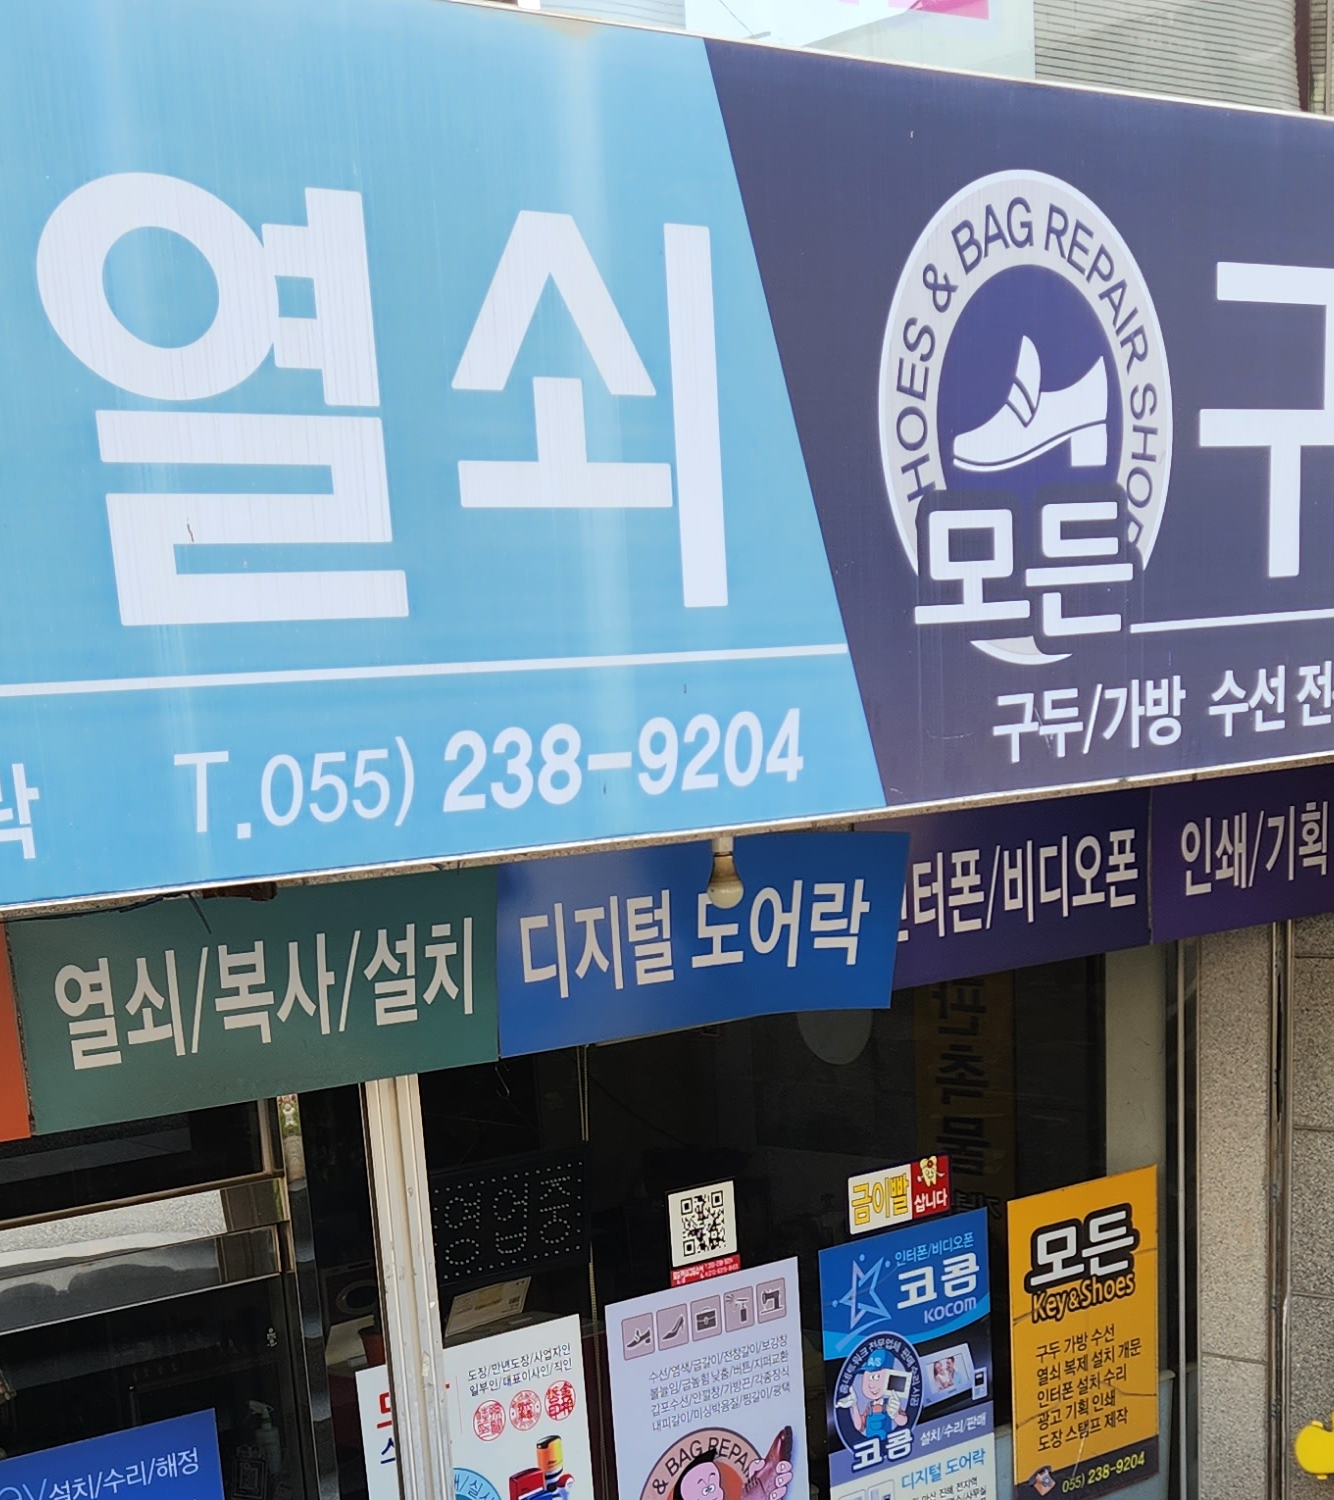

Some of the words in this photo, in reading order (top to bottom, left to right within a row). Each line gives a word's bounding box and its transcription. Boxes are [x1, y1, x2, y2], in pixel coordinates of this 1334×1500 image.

[895, 316, 937, 503] HOES
[922, 262, 959, 314] &
[951, 196, 1034, 276] BAG
[1044, 202, 1149, 376] REPAIR
[36, 171, 729, 627] 열쇠
[914, 500, 1135, 637] 모든
[992, 682, 1183, 766] 구두/가방
[1207, 663, 1286, 739] 수선
[442, 707, 805, 815] 238-9204
[1180, 800, 1332, 898] 인쇄/기획
[519, 888, 675, 999] 디지털
[691, 879, 870, 971] 도어락
[54, 916, 474, 1070] 열쇠/복사/설치
[851, 1173, 909, 1226] 금이빨
[914, 1188, 948, 1213] 삽니다
[895, 1231, 975, 1267] 인터폰/비디오폰
[1030, 1210, 1135, 1287] 모든
[897, 1252, 980, 1310] 코콤
[1031, 1273, 1136, 1324] Key&Shoes
[1035, 1341, 1062, 1364] 구두
[1063, 1332, 1089, 1355] 가방
[1091, 1323, 1116, 1347] 수선
[1036, 1366, 1062, 1388] 열쇠
[1063, 1353, 1089, 1377] 복제
[1091, 1345, 1116, 1370] 설치
[1118, 1337, 1143, 1360] 개문
[1037, 1381, 1075, 1409] 인터폰
[1077, 1372, 1102, 1397] 설치
[1103, 1364, 1128, 1384] 수리
[1037, 1408, 1063, 1432] 광고
[1065, 1398, 1090, 1421] 기획
[1092, 1388, 1117, 1413] 인쇄
[852, 1429, 914, 1471] 코콤
[1037, 1430, 1063, 1453] 도장
[1104, 1407, 1129, 1429] 제작
[652, 1478, 669, 1495] &
[665, 1439, 703, 1476] BAG
[901, 1462, 942, 1490] 디지털
[945, 1448, 986, 1471] 도어락
[1062, 1473, 1086, 1494] 055)
[1087, 1451, 1147, 1486] 238-9204
